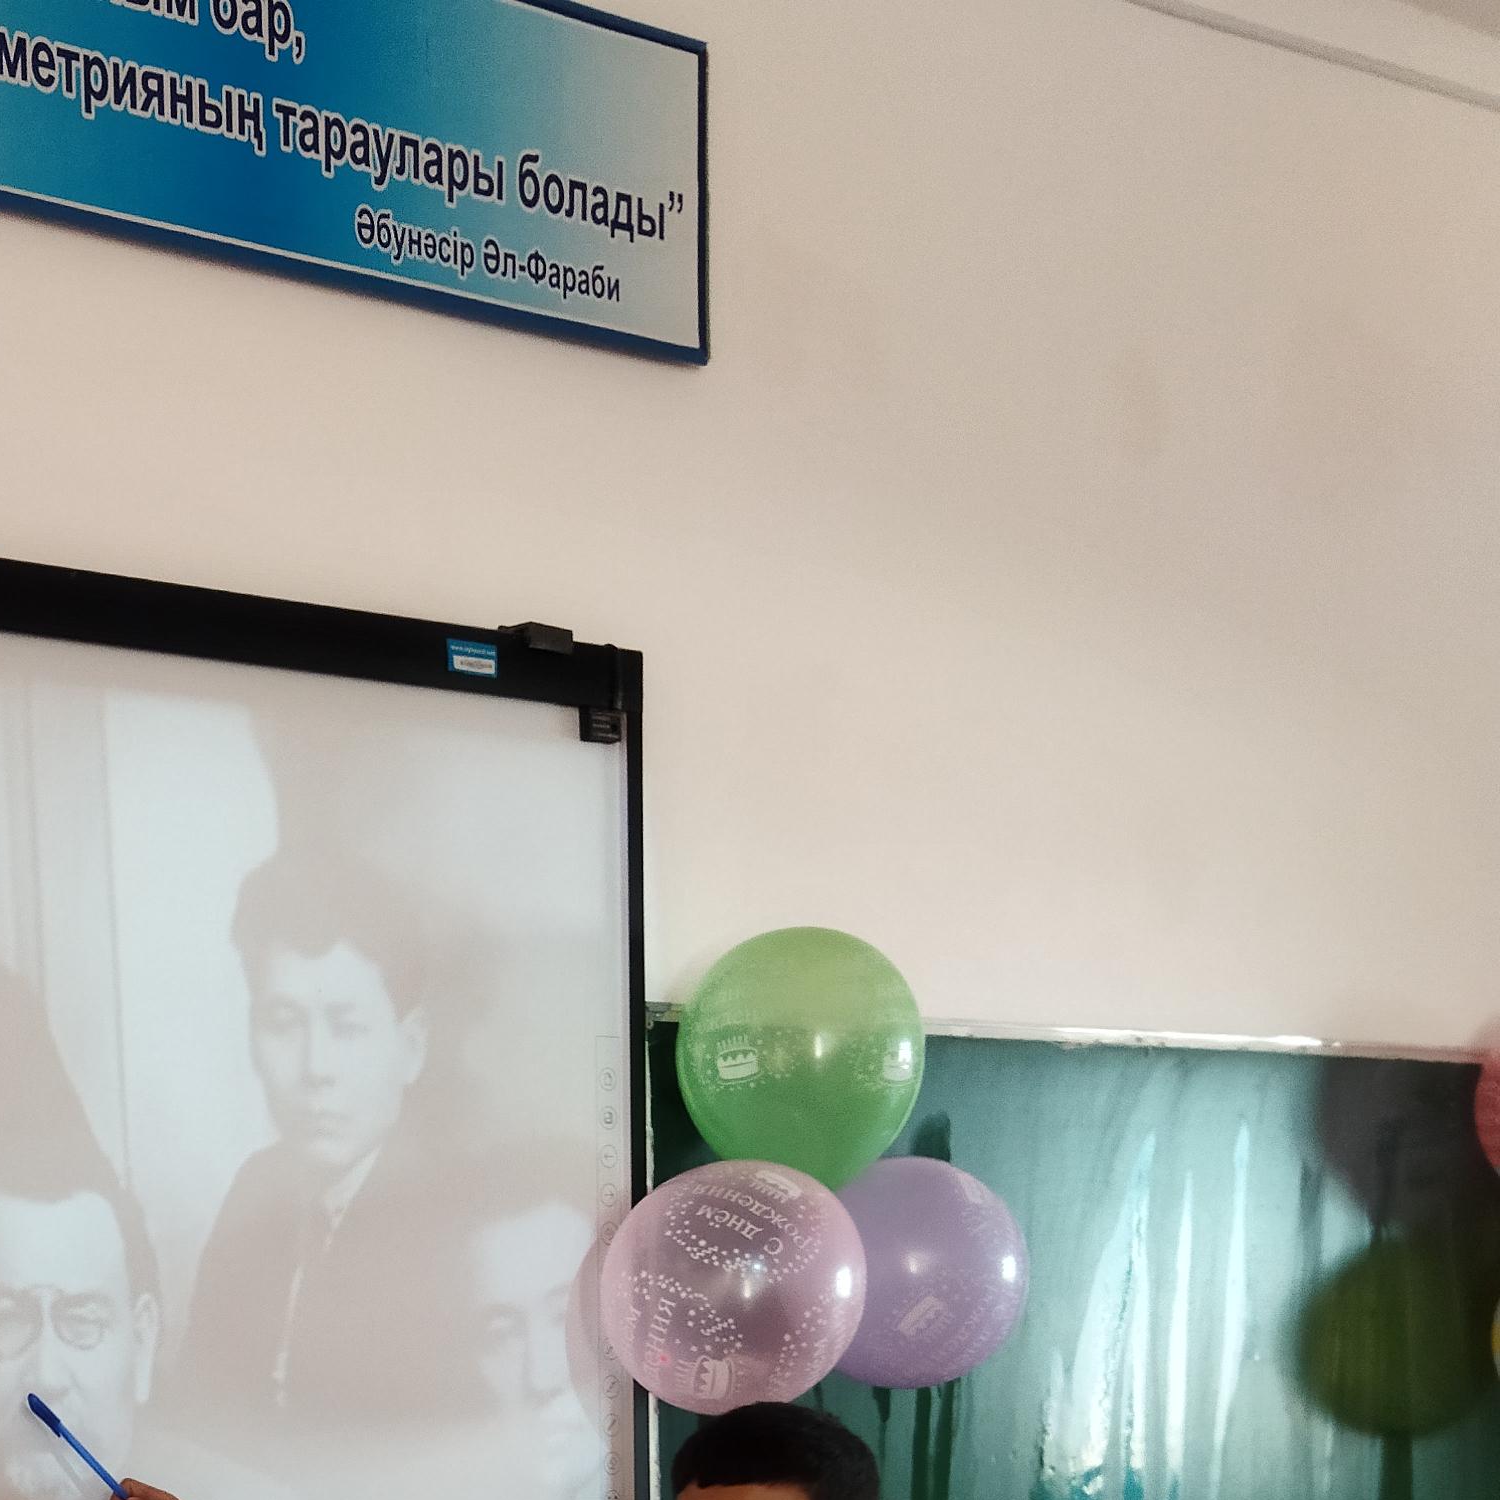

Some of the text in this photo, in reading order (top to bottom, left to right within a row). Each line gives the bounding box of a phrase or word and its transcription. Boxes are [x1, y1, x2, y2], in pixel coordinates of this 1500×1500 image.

[275, 103, 504, 204] тараулары
[356, 208, 621, 302] Әбунәсір Әл-Фараби
